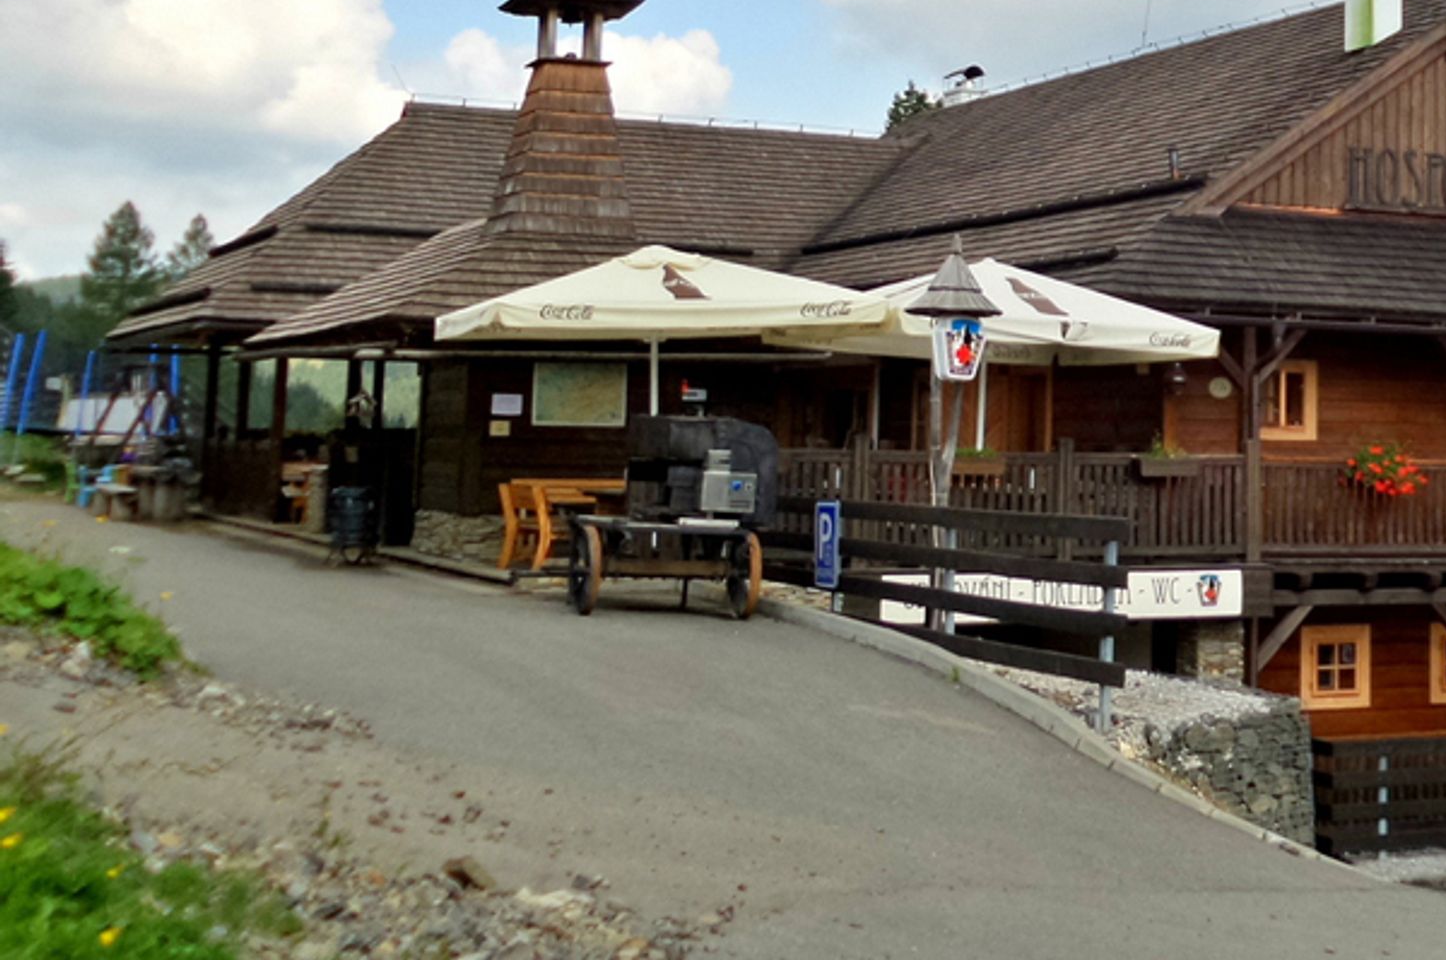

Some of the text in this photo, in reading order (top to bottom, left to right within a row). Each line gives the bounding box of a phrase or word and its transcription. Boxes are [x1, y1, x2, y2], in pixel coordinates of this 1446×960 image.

[819, 512, 833, 560] P
[1034, 579, 1132, 607] POKLADA
[1151, 577, 1181, 605] WC
